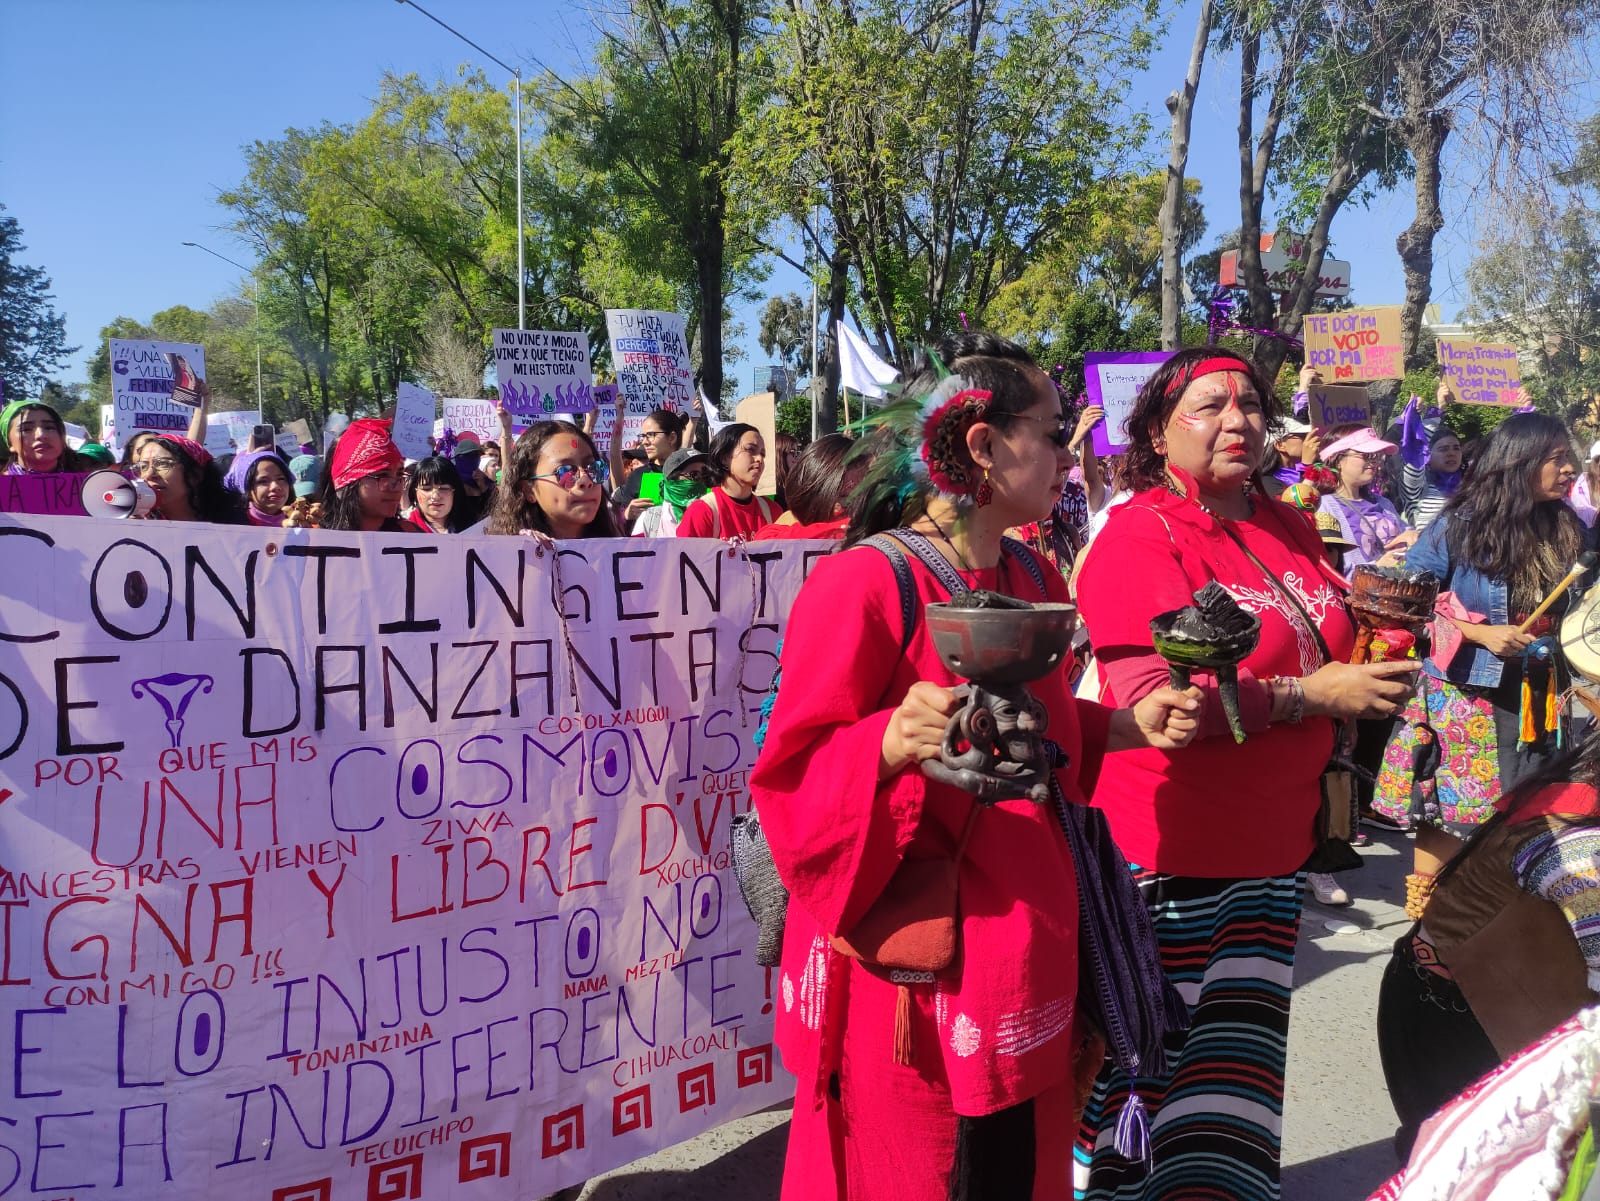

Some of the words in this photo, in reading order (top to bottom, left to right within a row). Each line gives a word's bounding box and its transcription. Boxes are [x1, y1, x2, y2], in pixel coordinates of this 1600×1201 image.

[637, 315, 663, 331] HIJA
[1308, 317, 1328, 334] TE
[1361, 316, 1377, 329] MI
[501, 332, 515, 345] NO
[517, 332, 541, 346] VINE
[543, 334, 549, 346] X
[551, 335, 578, 349] MODA
[641, 328, 681, 345] ESTUDIA
[1333, 329, 1380, 351] VOTO
[496, 348, 520, 360] VINE
[522, 348, 529, 359] X
[531, 348, 548, 361] QUE
[551, 349, 584, 362] TENGO
[664, 343, 685, 358] PARA
[1310, 348, 1336, 367] POR
[1340, 350, 1362, 366] MI
[513, 363, 527, 375] MI
[529, 363, 576, 375] HISTORIA
[624, 353, 672, 368] DEFENDER
[135, 365, 176, 378] VUELV
[623, 364, 650, 374] HACER
[652, 365, 689, 379] JUSTICIA
[1466, 364, 1485, 376] NO
[621, 374, 637, 384] POR
[640, 374, 659, 386] LAS
[626, 385, 654, 393] ESTAN
[659, 385, 667, 396] Y
[118, 395, 143, 411] CON
[147, 397, 163, 411] SU
[630, 402, 647, 413] QUE
[135, 413, 187, 428] HISTORIA
[239, 624, 780, 738] DANZANTAS
[35, 757, 123, 788] POR
[158, 742, 227, 774] QUE
[251, 736, 317, 768] MIS
[91, 763, 278, 868] UNA
[421, 811, 514, 846] ZIWA
[0, 857, 200, 899] ANCESTRAS
[240, 835, 357, 876] VIENEN
[308, 863, 347, 938] Y
[391, 817, 607, 921] LIBRE
[118, 989, 226, 1088] LO
[266, 908, 600, 1061] INJUSTO
[640, 873, 722, 963] NO
[564, 974, 609, 999] NANA
[625, 949, 684, 983] MEZTLI
[287, 1022, 434, 1077] TONANZINA
[613, 1025, 745, 1087] CIHUACOALT
[346, 1115, 474, 1167] TECUICHPO
